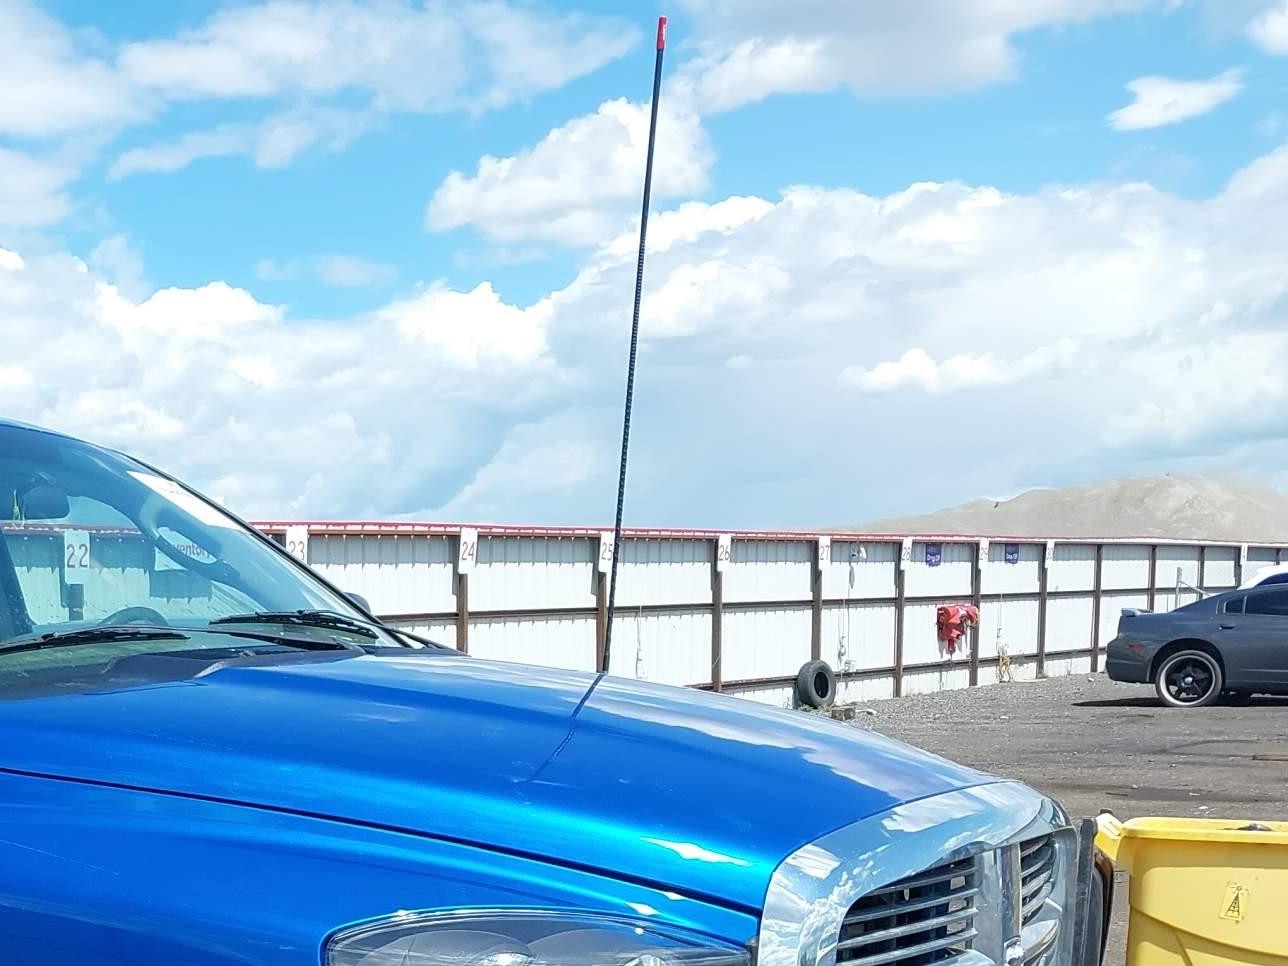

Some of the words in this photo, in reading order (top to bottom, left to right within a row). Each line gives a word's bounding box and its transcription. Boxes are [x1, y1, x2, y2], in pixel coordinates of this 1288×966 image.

[66, 543, 88, 568] 22
[461, 541, 475, 561] 24
[601, 542, 613, 561] 25
[719, 544, 730, 561] 26
[819, 545, 830, 560] 27
